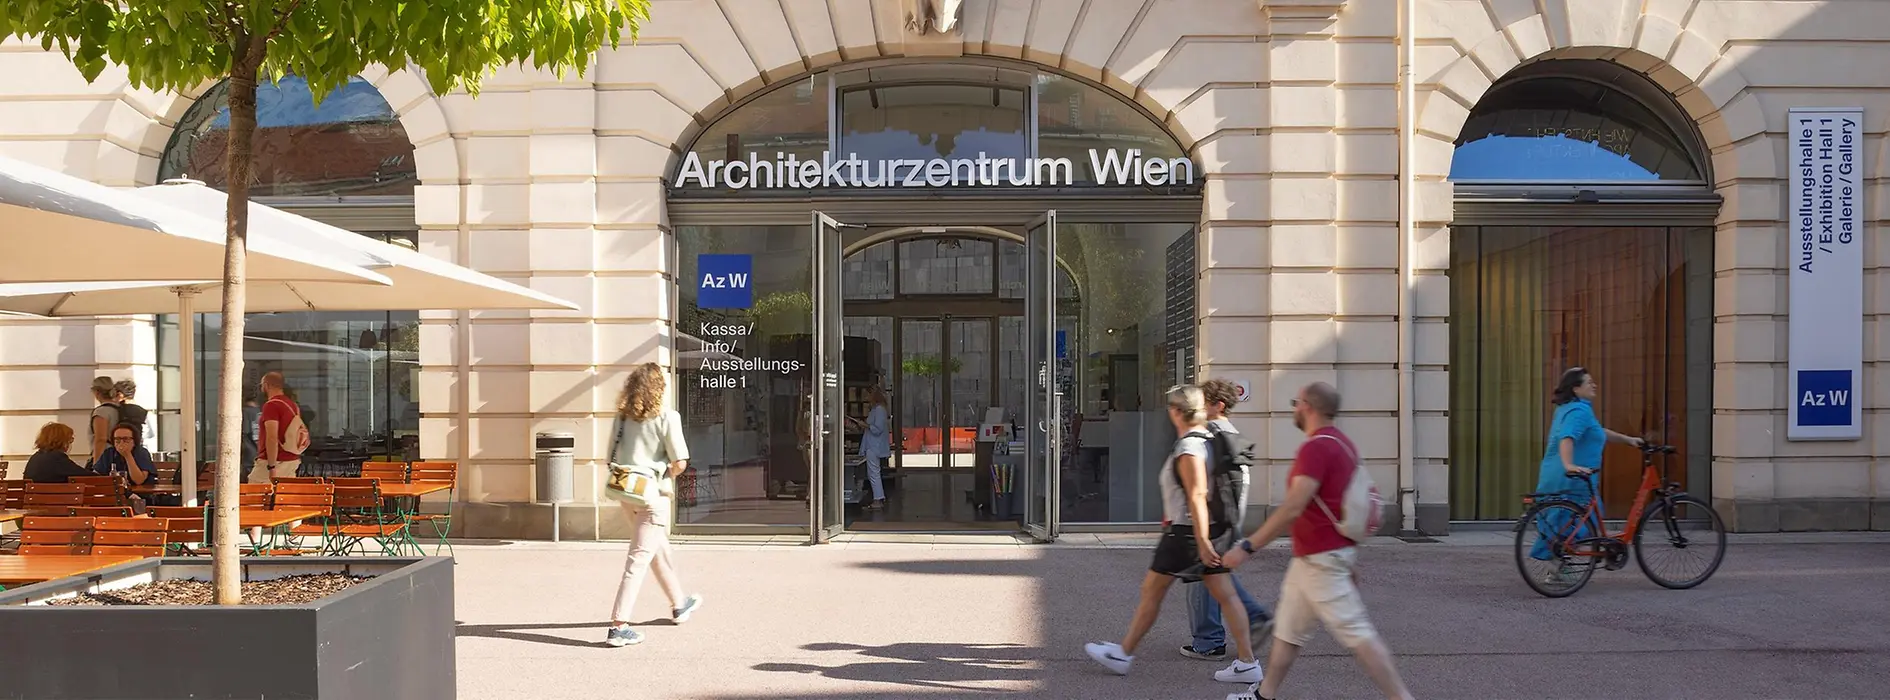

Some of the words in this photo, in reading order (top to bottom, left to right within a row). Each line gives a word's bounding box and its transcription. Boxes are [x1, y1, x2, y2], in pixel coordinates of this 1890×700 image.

[1819, 129, 1833, 160] Hall
[675, 150, 1072, 188] Architekturzentrum
[1088, 148, 1194, 186] Wien
[1799, 129, 1816, 273] Ausstellungshalle
[1819, 164, 1833, 244] Exhibition
[700, 357, 806, 374] Ausstellungs-
[700, 375, 737, 388] halle
[739, 375, 747, 388] 1
